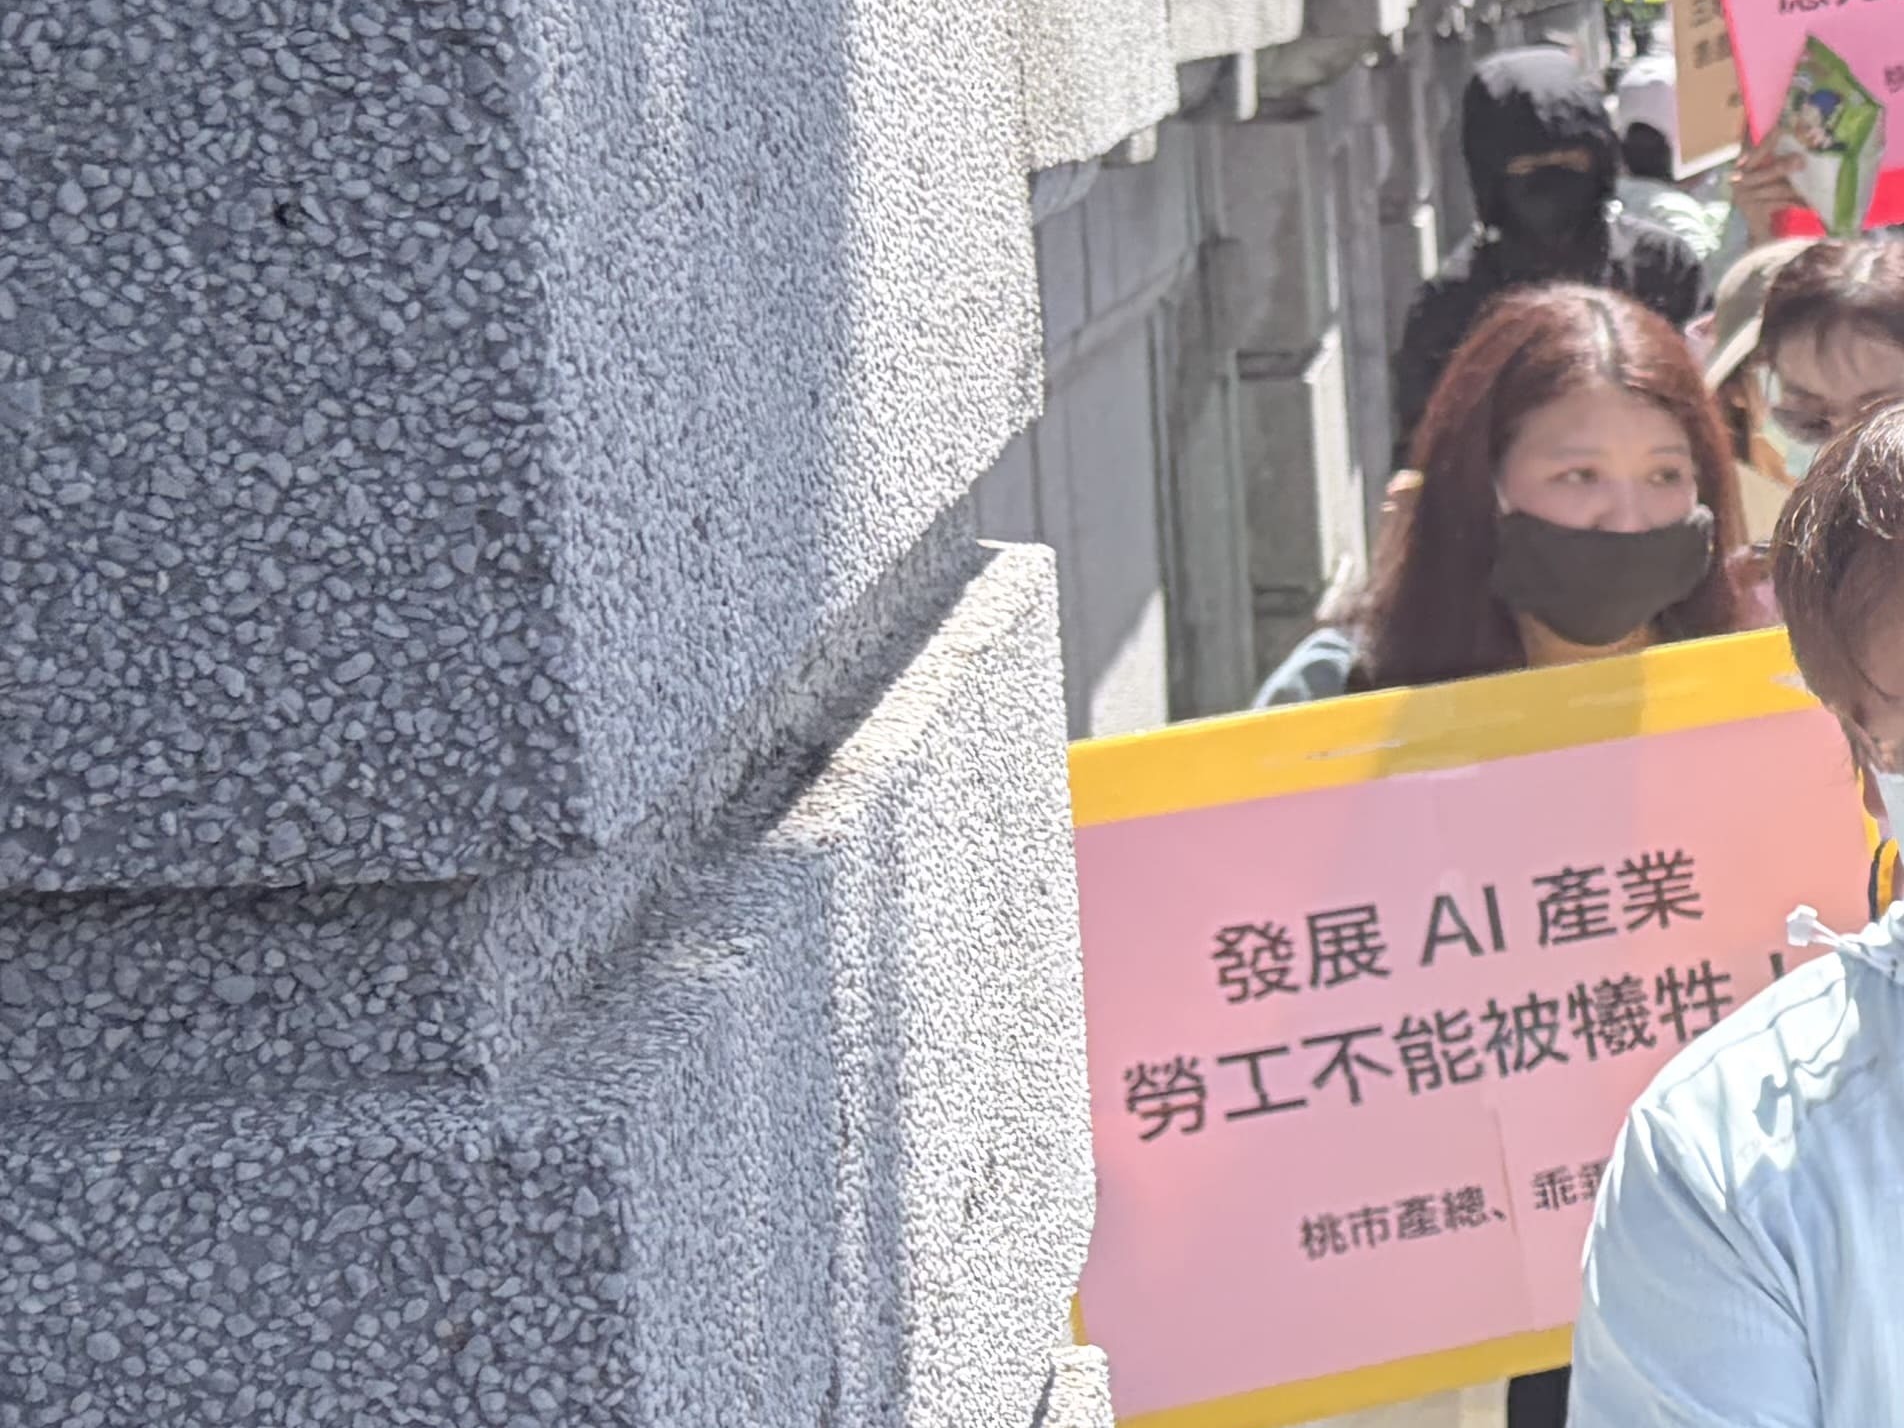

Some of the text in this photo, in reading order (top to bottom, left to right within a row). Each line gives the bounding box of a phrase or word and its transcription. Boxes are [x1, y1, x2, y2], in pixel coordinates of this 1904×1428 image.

[1211, 848, 1705, 1004] 發展 AI 產業
[1123, 950, 1785, 1141] 勞工不能被犧牲
